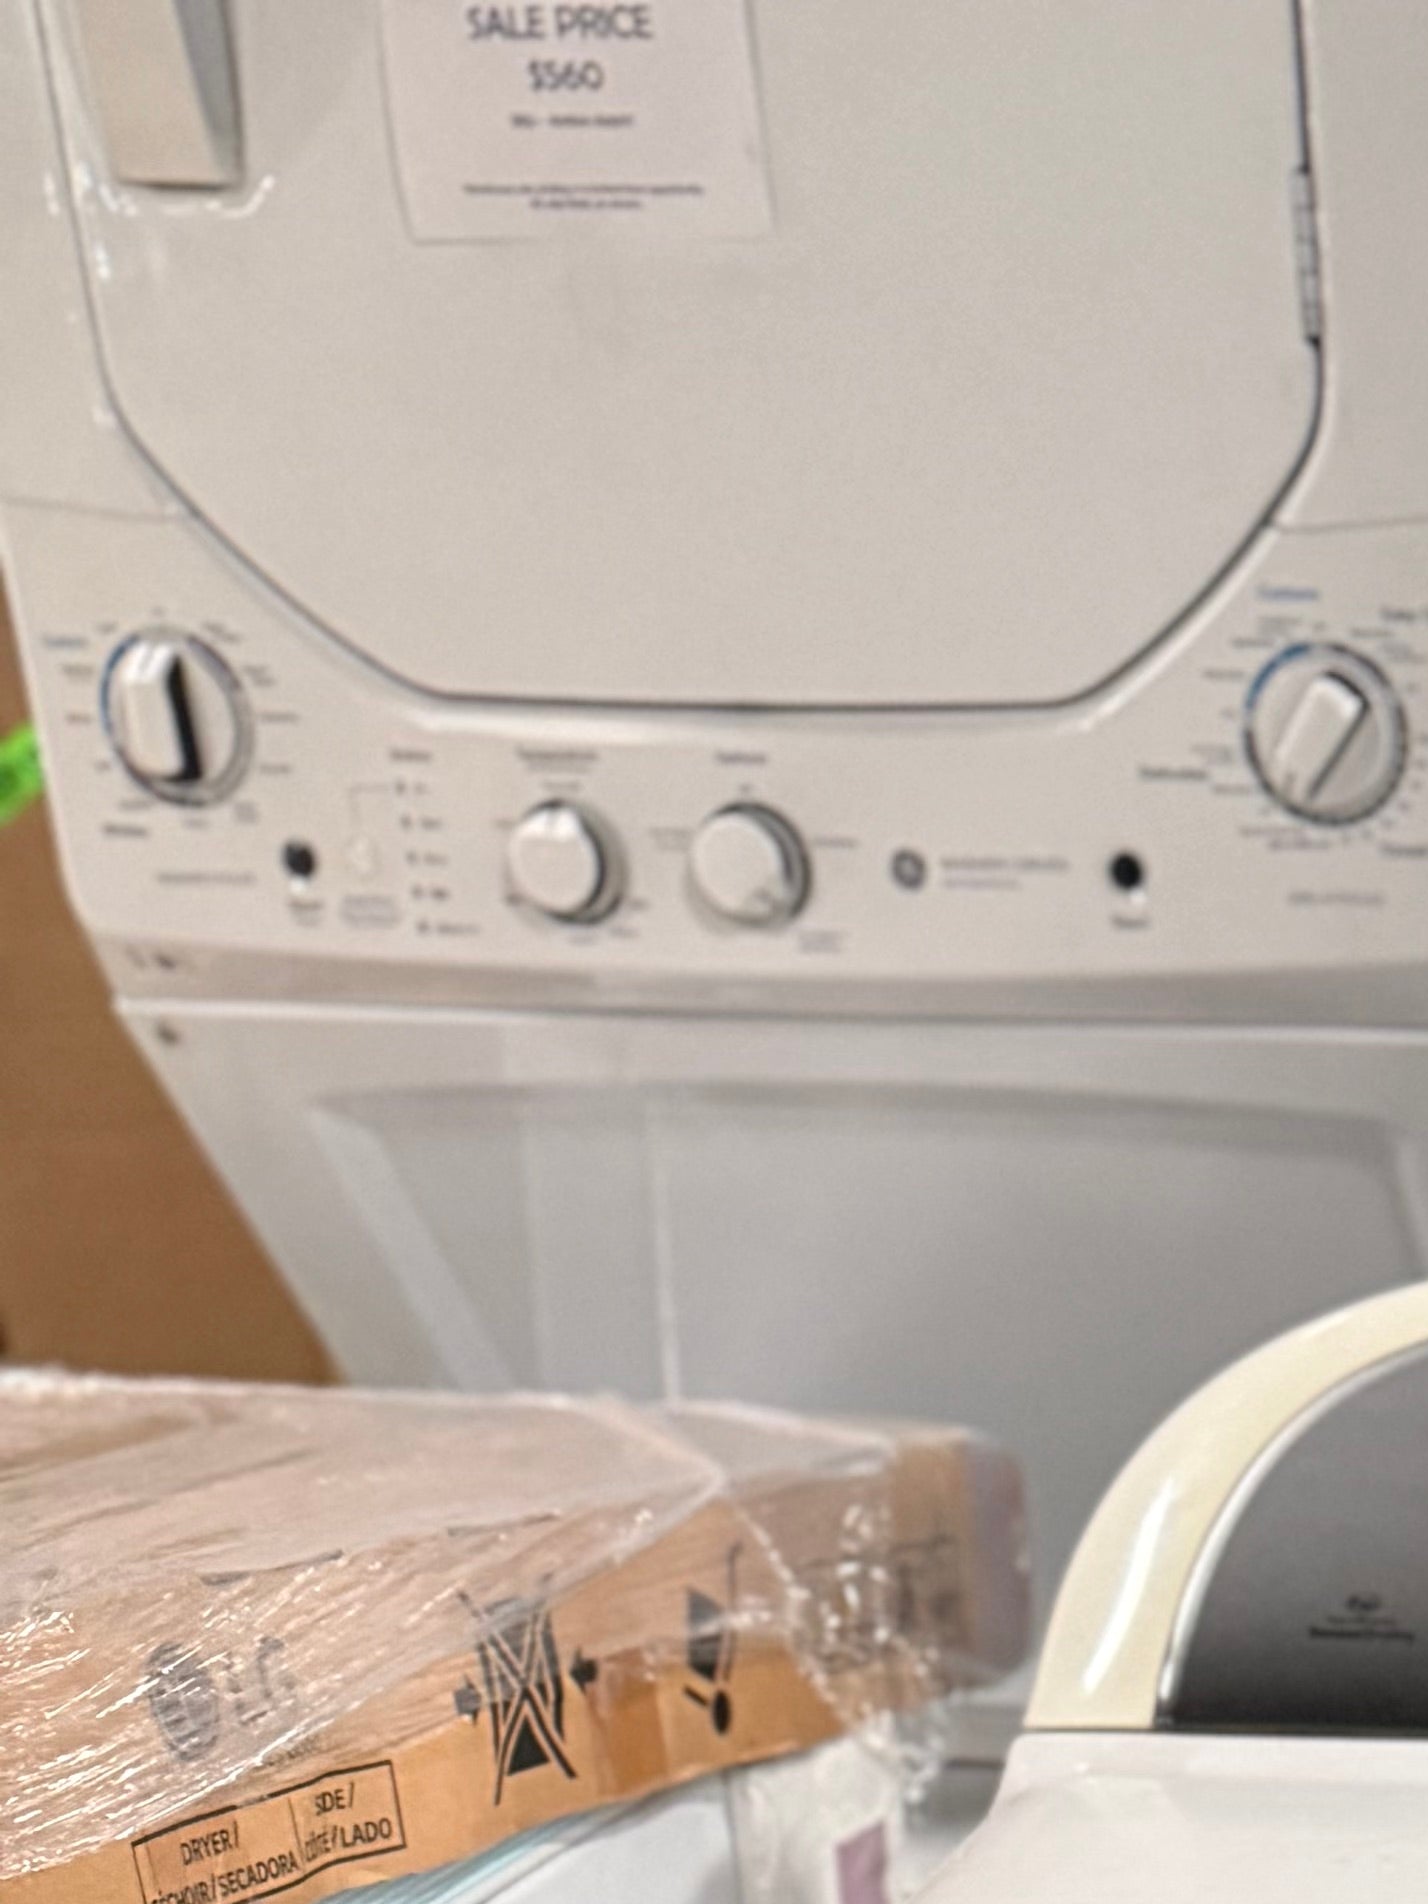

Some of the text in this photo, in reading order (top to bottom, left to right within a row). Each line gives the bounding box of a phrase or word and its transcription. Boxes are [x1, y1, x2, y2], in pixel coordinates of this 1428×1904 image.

[466, 4, 655, 41] SALE PRICE
[180, 1819, 240, 1867] DRYER/
